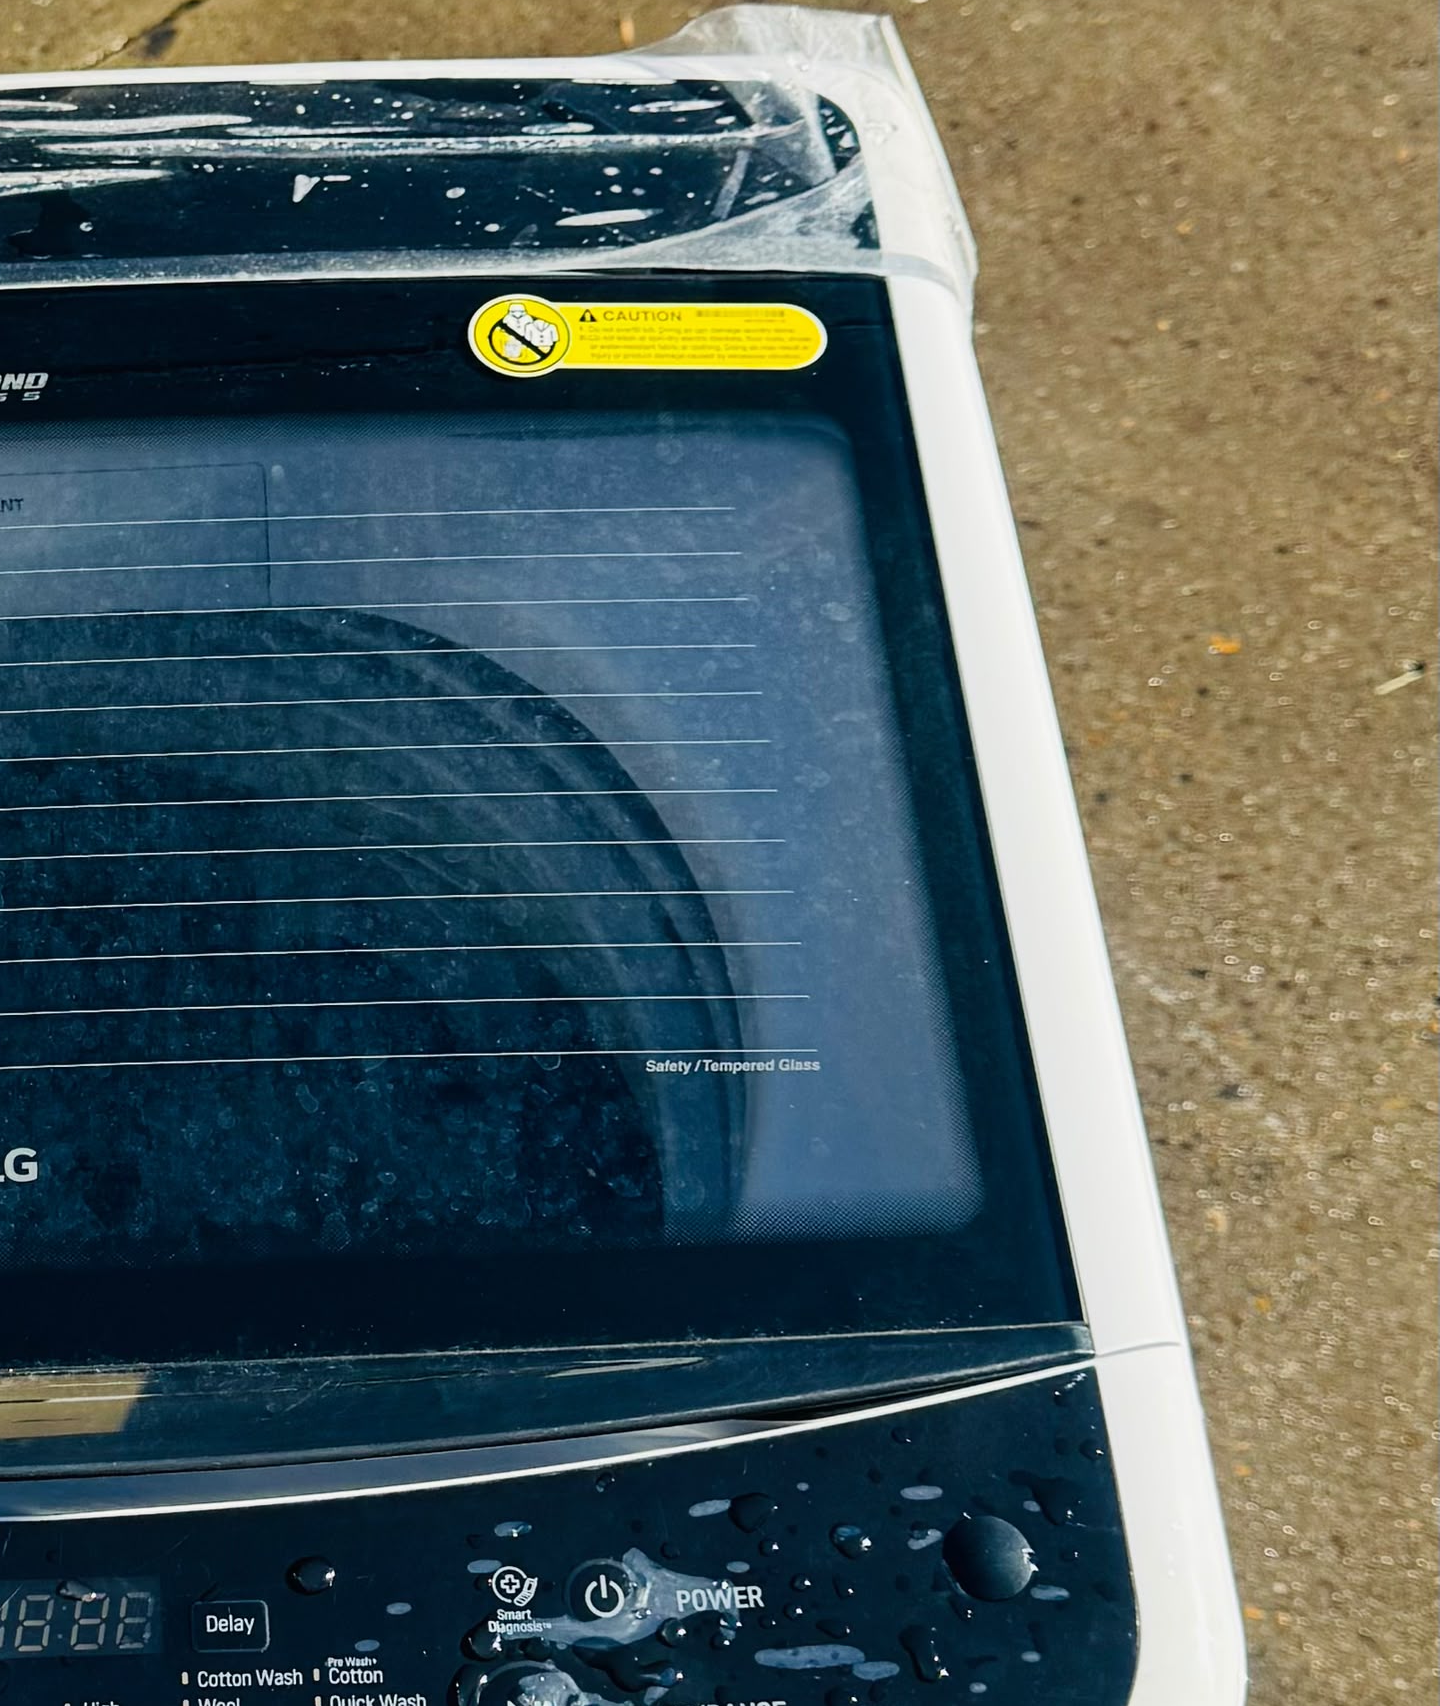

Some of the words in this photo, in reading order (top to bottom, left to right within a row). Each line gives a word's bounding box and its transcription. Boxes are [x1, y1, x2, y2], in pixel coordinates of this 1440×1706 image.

[603, 310, 682, 322] CAUTION
[645, 1059, 692, 1075] Safety
[778, 1058, 821, 1072] Glass
[676, 1586, 765, 1612] POWER
[496, 1608, 533, 1621] Smart
[205, 1614, 255, 1636] Delay
[197, 1671, 252, 1688] Cotton
[256, 1669, 303, 1686] Wash
[328, 1667, 384, 1685] Cotton
